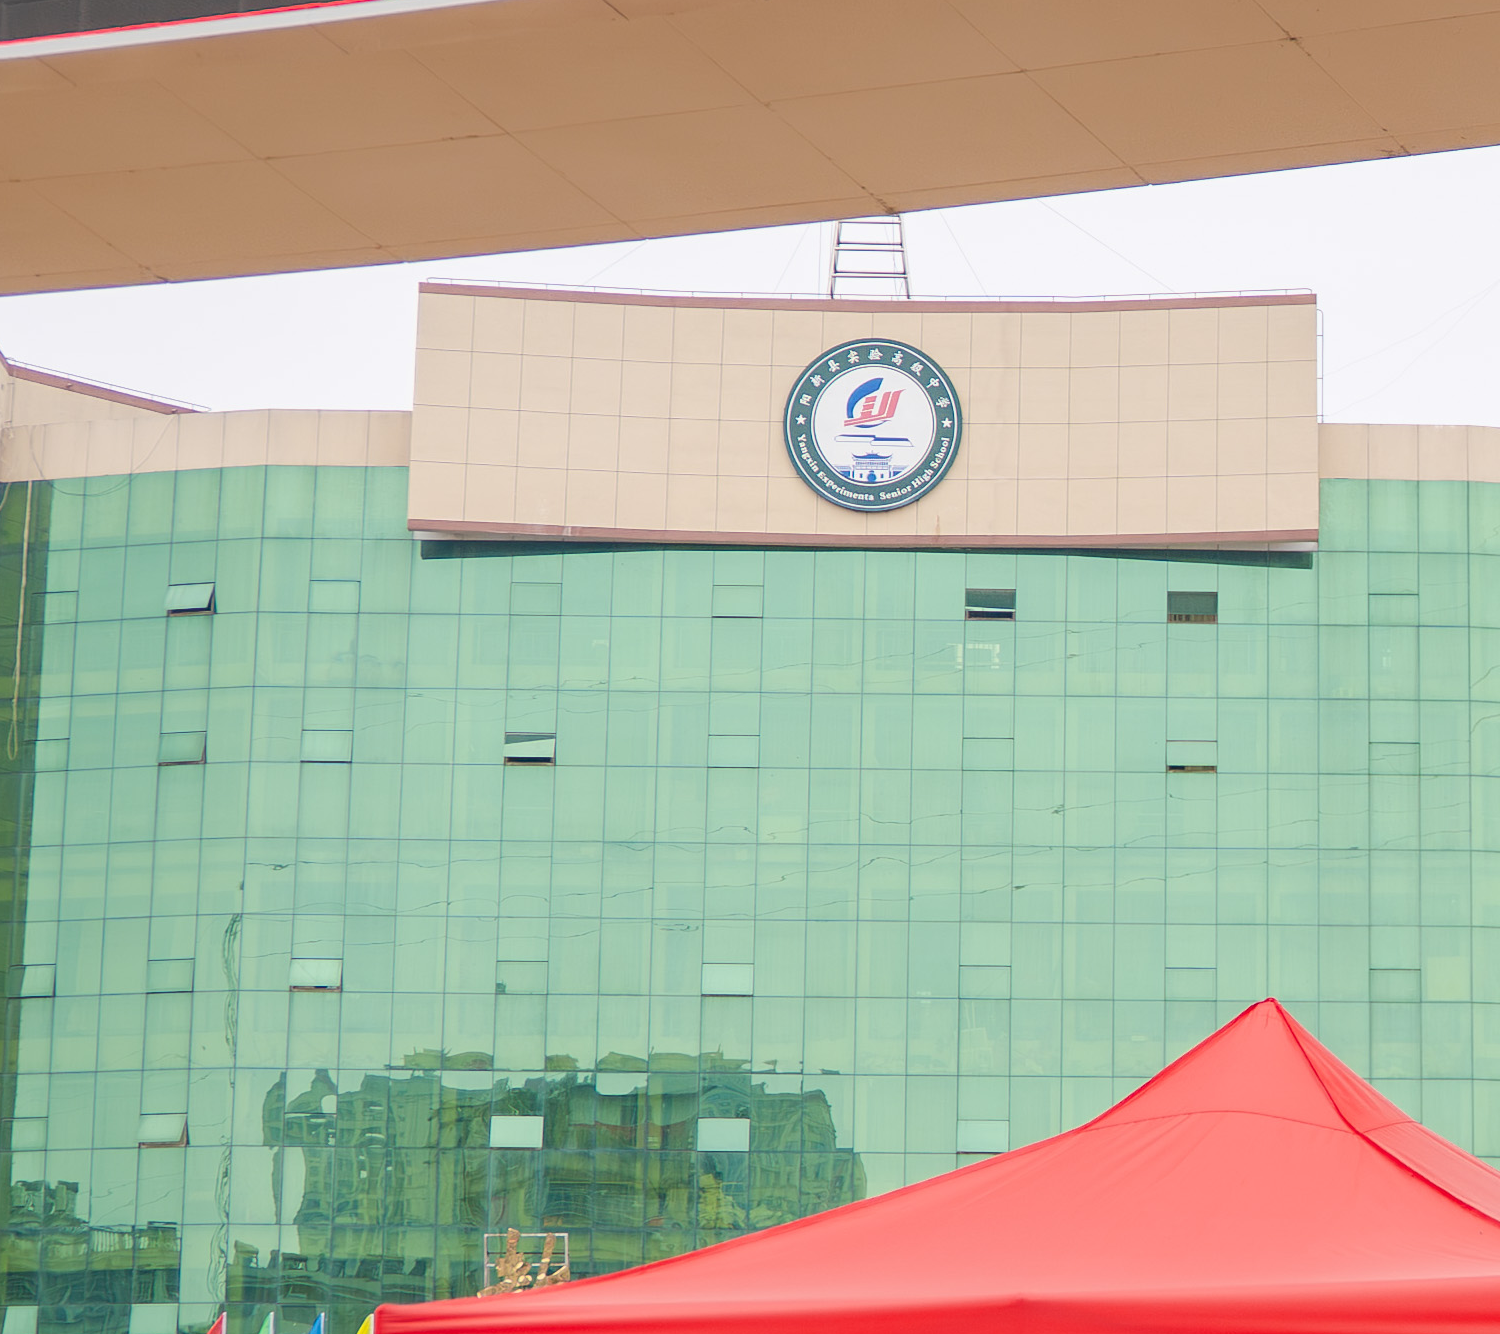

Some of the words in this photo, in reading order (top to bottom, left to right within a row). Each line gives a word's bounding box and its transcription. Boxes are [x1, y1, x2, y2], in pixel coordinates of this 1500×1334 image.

[797, 433, 820, 473] Yangxin
[879, 485, 912, 501] Senior
[911, 468, 934, 488] High
[929, 436, 951, 469] School
